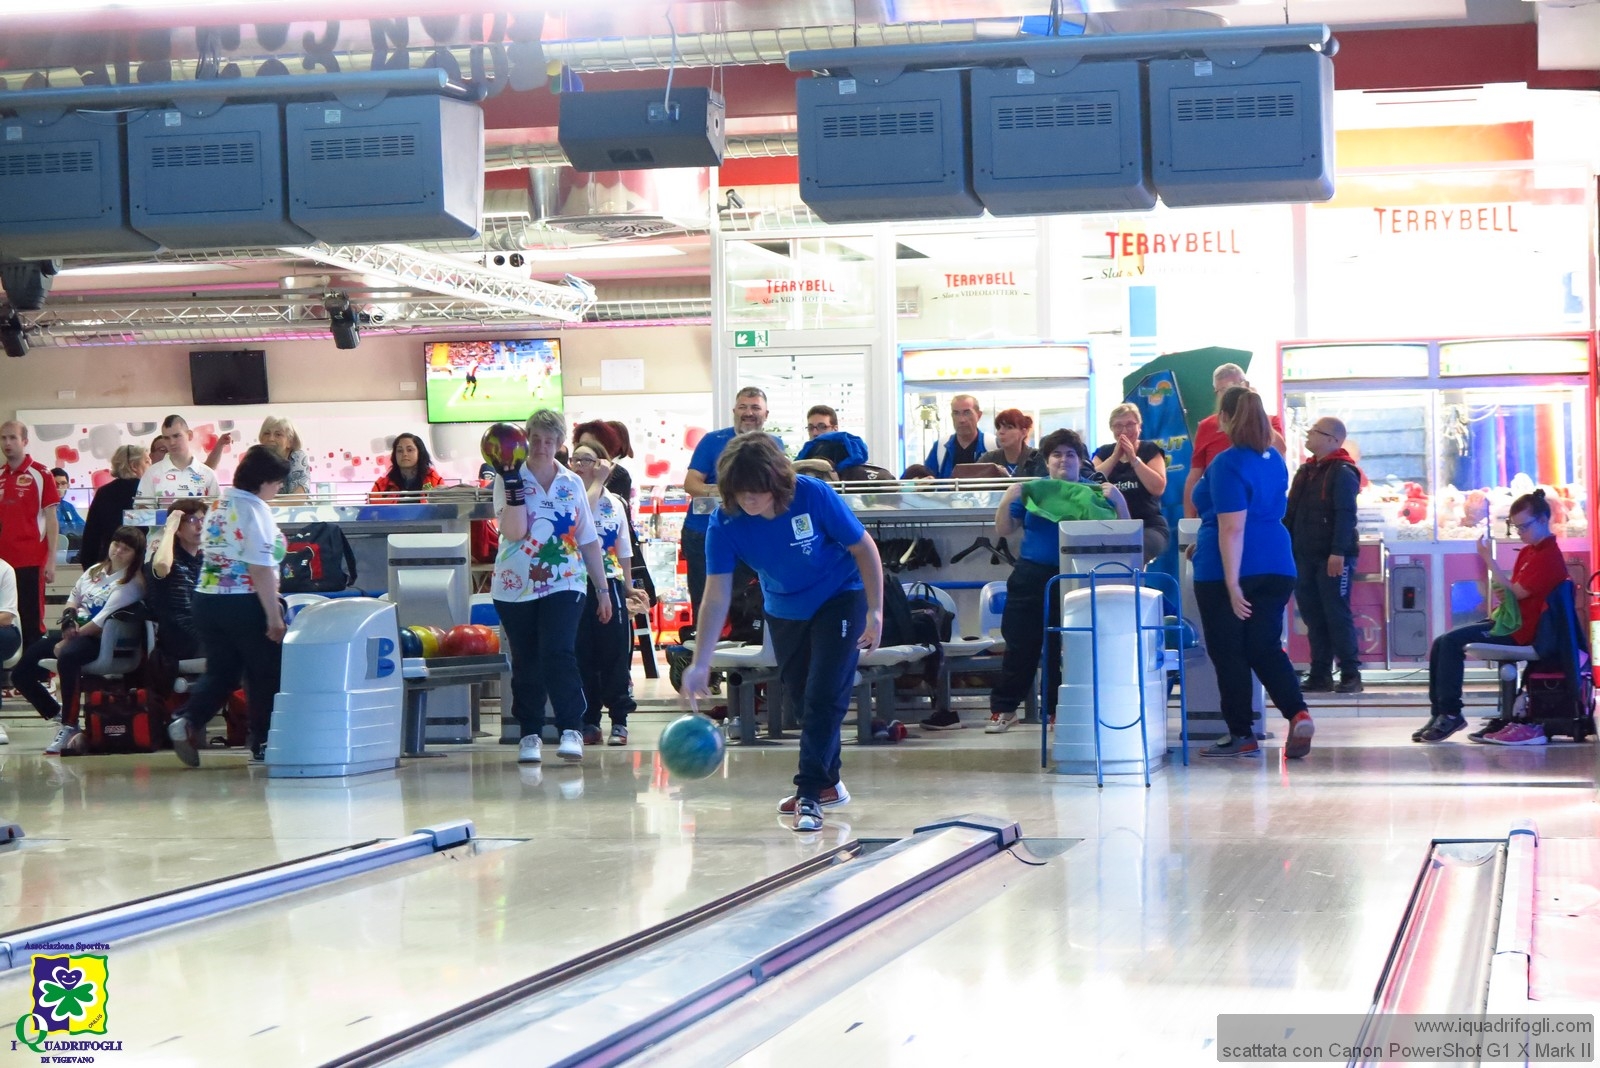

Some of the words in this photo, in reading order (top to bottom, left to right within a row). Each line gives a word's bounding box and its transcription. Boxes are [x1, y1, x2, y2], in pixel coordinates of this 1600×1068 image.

[1373, 205, 1518, 235] TERRYBELL
[1105, 229, 1241, 259] TERRYBELL
[766, 279, 835, 294] TERRYBELL
[944, 271, 1016, 288] TERRYBELL
